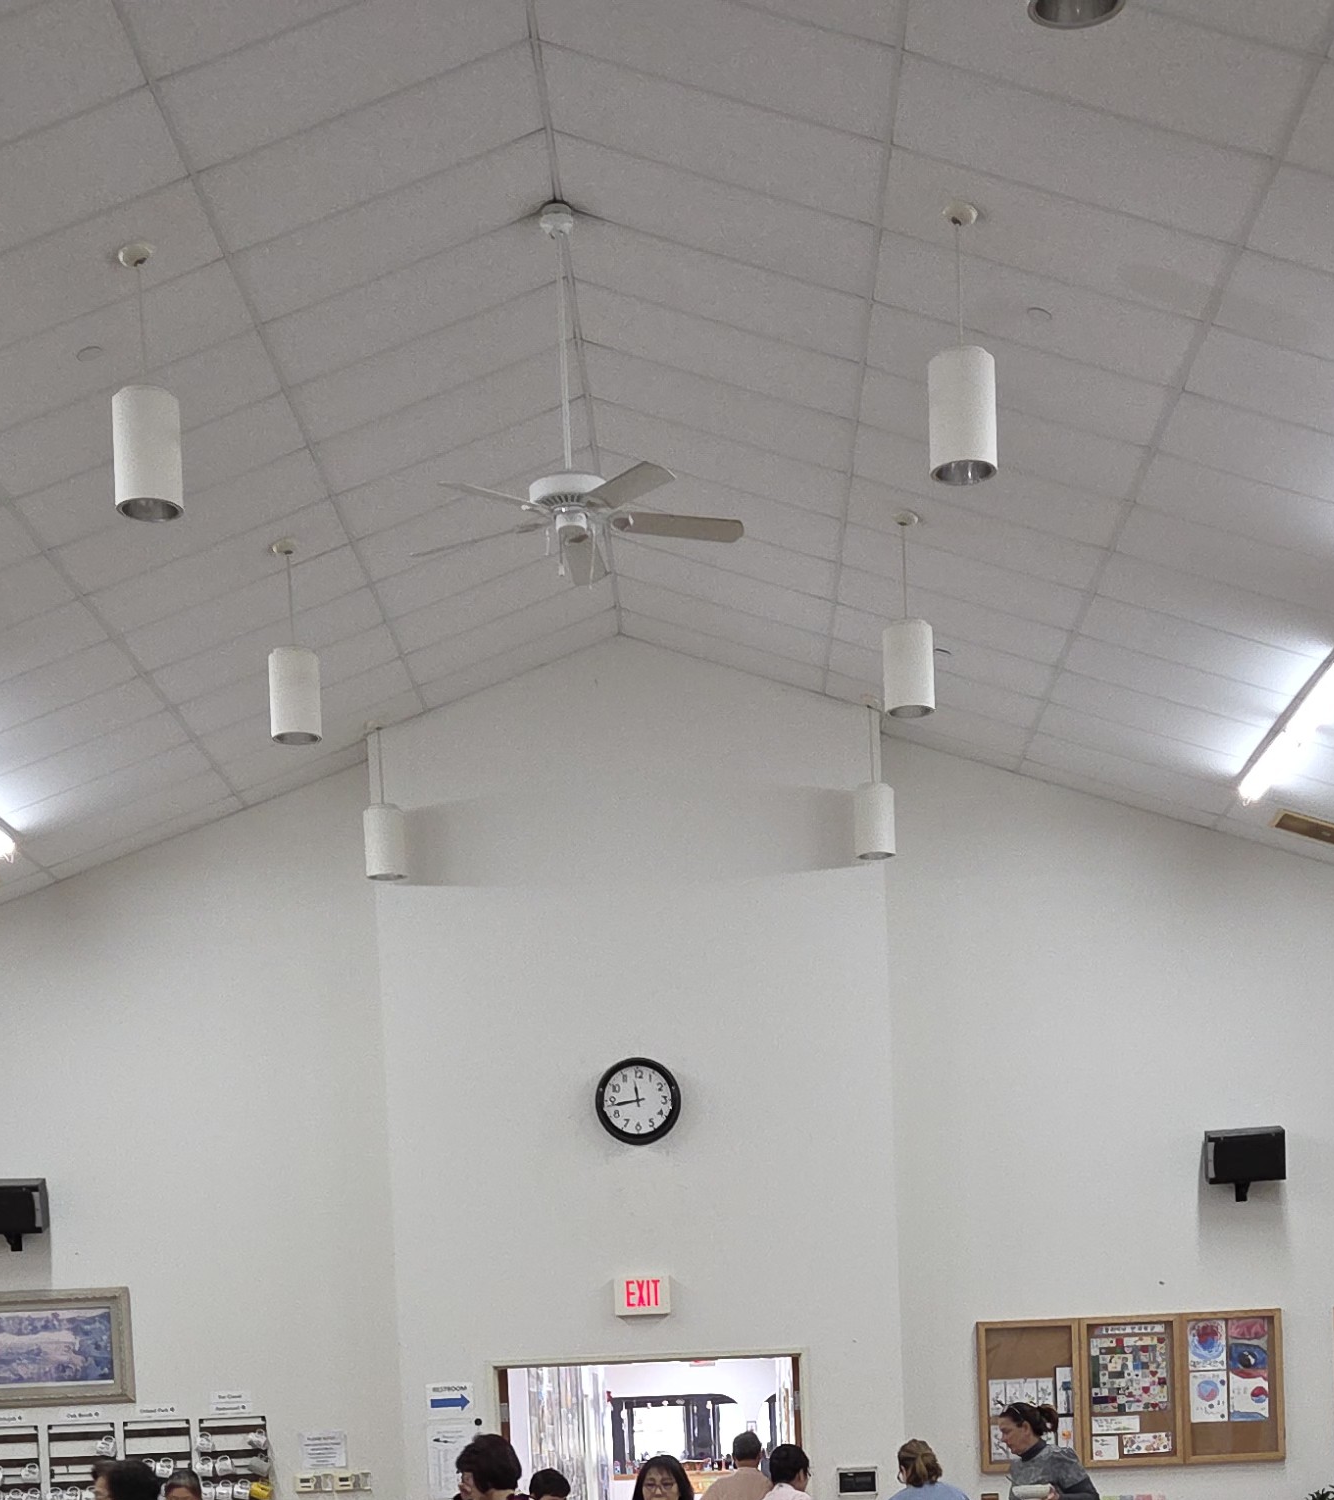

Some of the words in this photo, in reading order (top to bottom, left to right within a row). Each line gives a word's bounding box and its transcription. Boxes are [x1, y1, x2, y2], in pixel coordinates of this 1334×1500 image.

[622, 1074, 628, 1083] 11
[635, 1069, 643, 1079] 12
[612, 1083, 621, 1093] 10
[656, 1082, 664, 1092] 2
[609, 1095, 616, 1106] 9
[661, 1095, 668, 1105] 3
[613, 1109, 620, 1118] 8
[657, 1108, 664, 1117] 4
[623, 1118, 630, 1128] 7
[635, 1121, 642, 1131] 6
[648, 1118, 655, 1128] 5
[625, 1279, 660, 1307] EXIT
